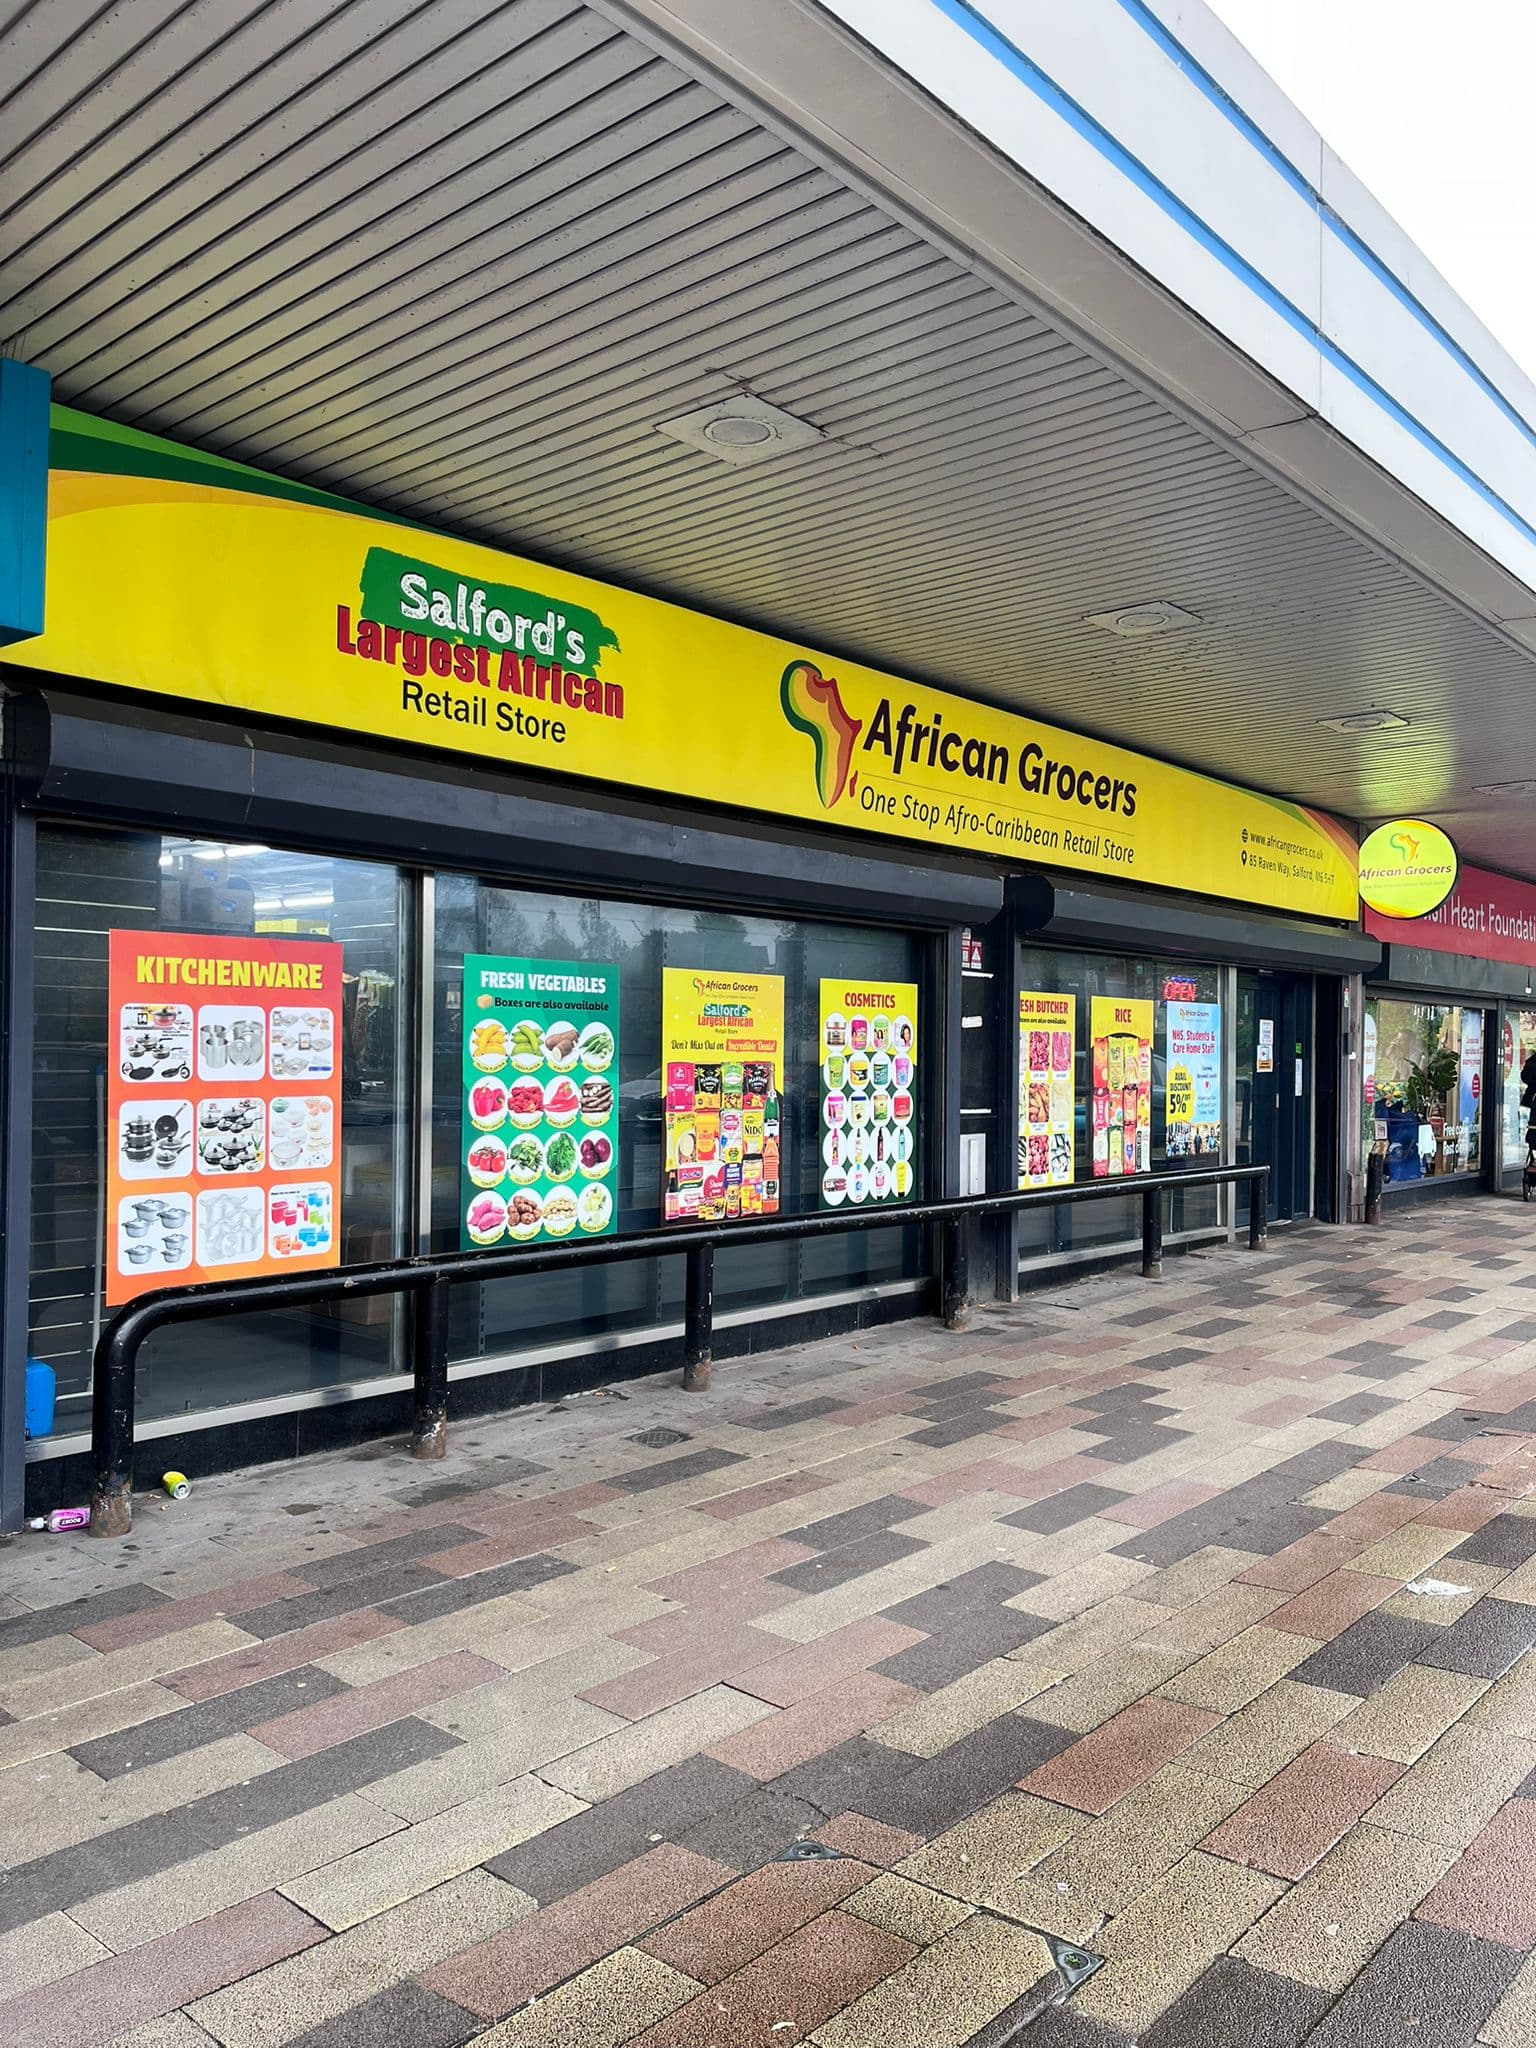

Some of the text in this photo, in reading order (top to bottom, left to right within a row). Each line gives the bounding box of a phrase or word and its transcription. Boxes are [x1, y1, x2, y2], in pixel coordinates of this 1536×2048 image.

[400, 573, 586, 665] Salford's
[337, 605, 624, 719] Largest African
[402, 680, 567, 743] Retail Store
[863, 698, 1138, 817] African Grocers
[861, 786, 1134, 863] One Stop Afro-Caribbean Retail Store
[1250, 832, 1324, 860] www.africangrocers.co.uk
[1249, 854, 1257, 867] 85
[1258, 857, 1276, 872] Raven
[1358, 865, 1452, 880] African Grocers
[1451, 895, 1486, 932] Heart
[136, 955, 323, 990] KITCHENWARE
[480, 970, 606, 994] FRESH VEGETABLES
[706, 980, 759, 992] African Grocers
[1165, 981, 1196, 1001] OPEN
[494, 997, 609, 1011] Boxes are also available
[844, 992, 896, 1008] COSMETICS
[1020, 999, 1069, 1014] ESH BUTCHER
[704, 1003, 748, 1016] Salford's
[1115, 1008, 1132, 1023] RICE
[698, 1014, 753, 1028] Largest African
[1186, 1029, 1210, 1041] Students
[671, 1039, 688, 1050] Don't
[1173, 1042, 1185, 1054] Care
[1186, 1043, 1200, 1054] Home
[1170, 1082, 1191, 1092] DISCOUNT
[1170, 1094, 1187, 1114] 5%
